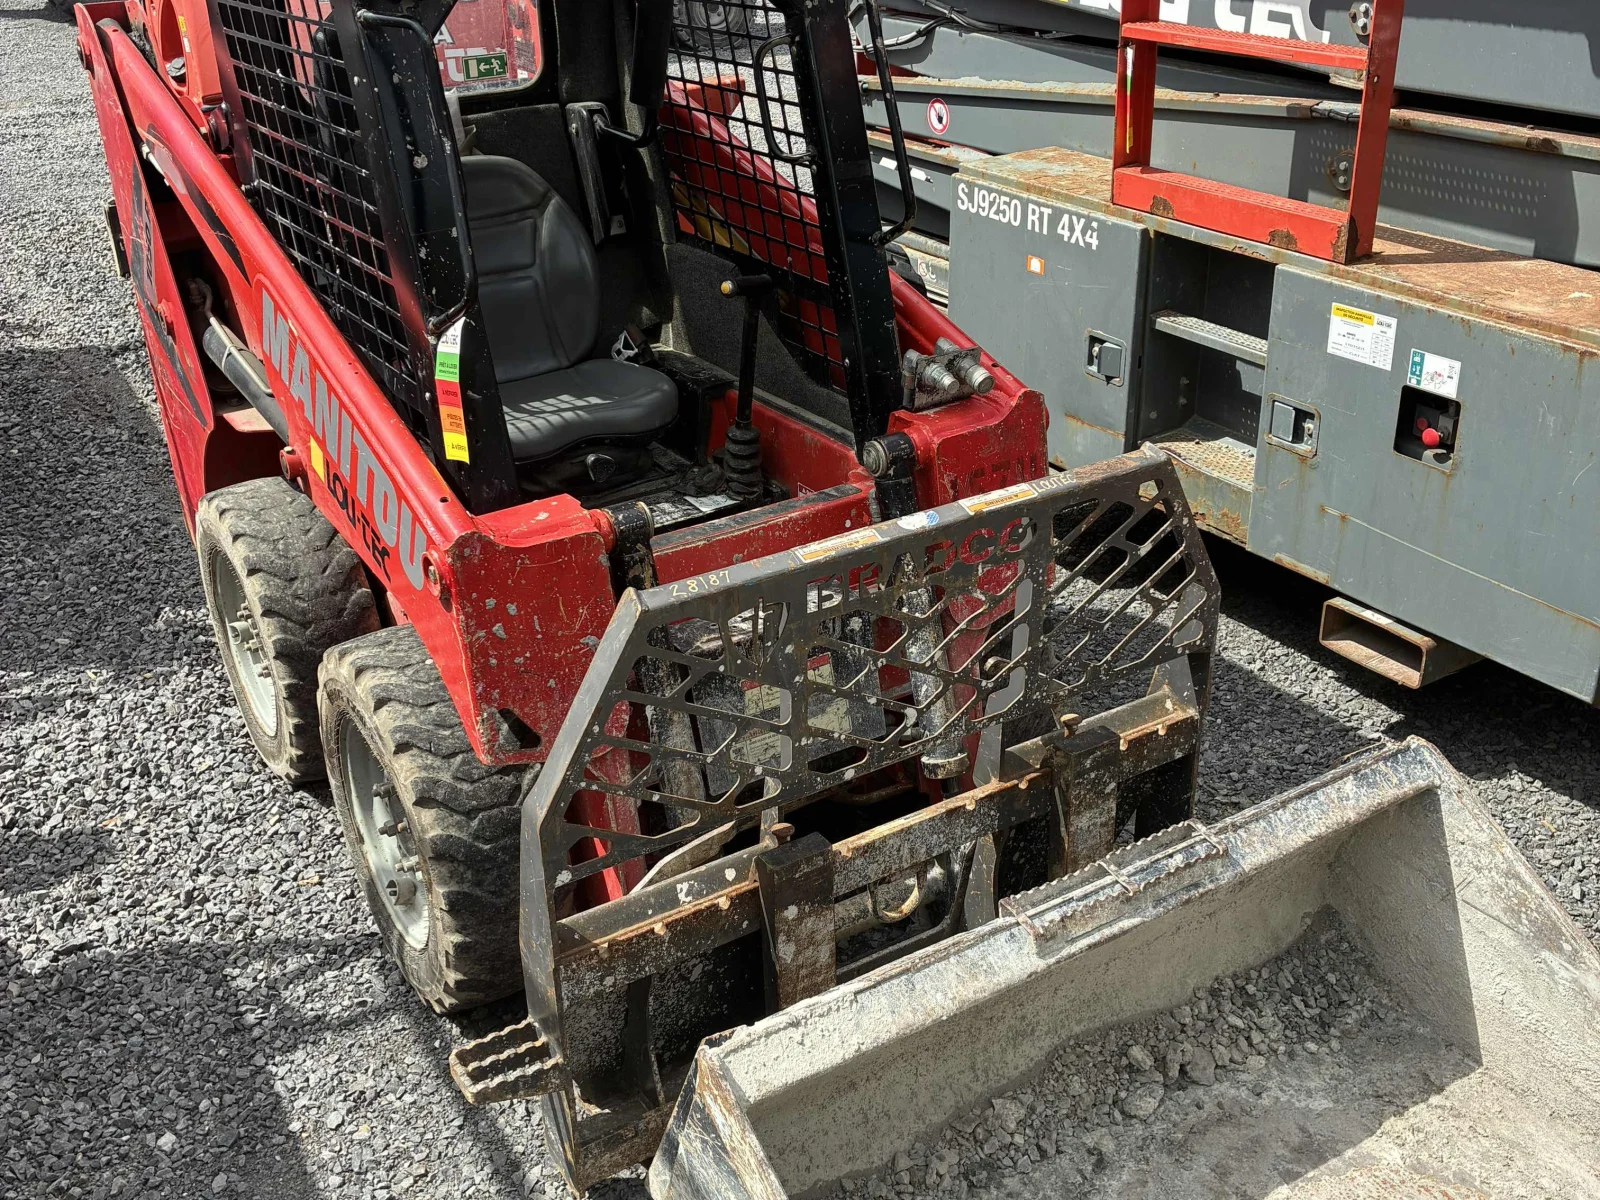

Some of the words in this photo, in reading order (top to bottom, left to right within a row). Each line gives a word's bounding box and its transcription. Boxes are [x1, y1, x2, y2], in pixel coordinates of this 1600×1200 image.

[957, 182, 1021, 227] SJ9250
[1027, 203, 1052, 235] RT
[1057, 213, 1099, 251] 4X4
[262, 288, 427, 591] MANITOU
[984, 495, 1013, 508] WARNING
[806, 517, 1036, 613] BRADCO
